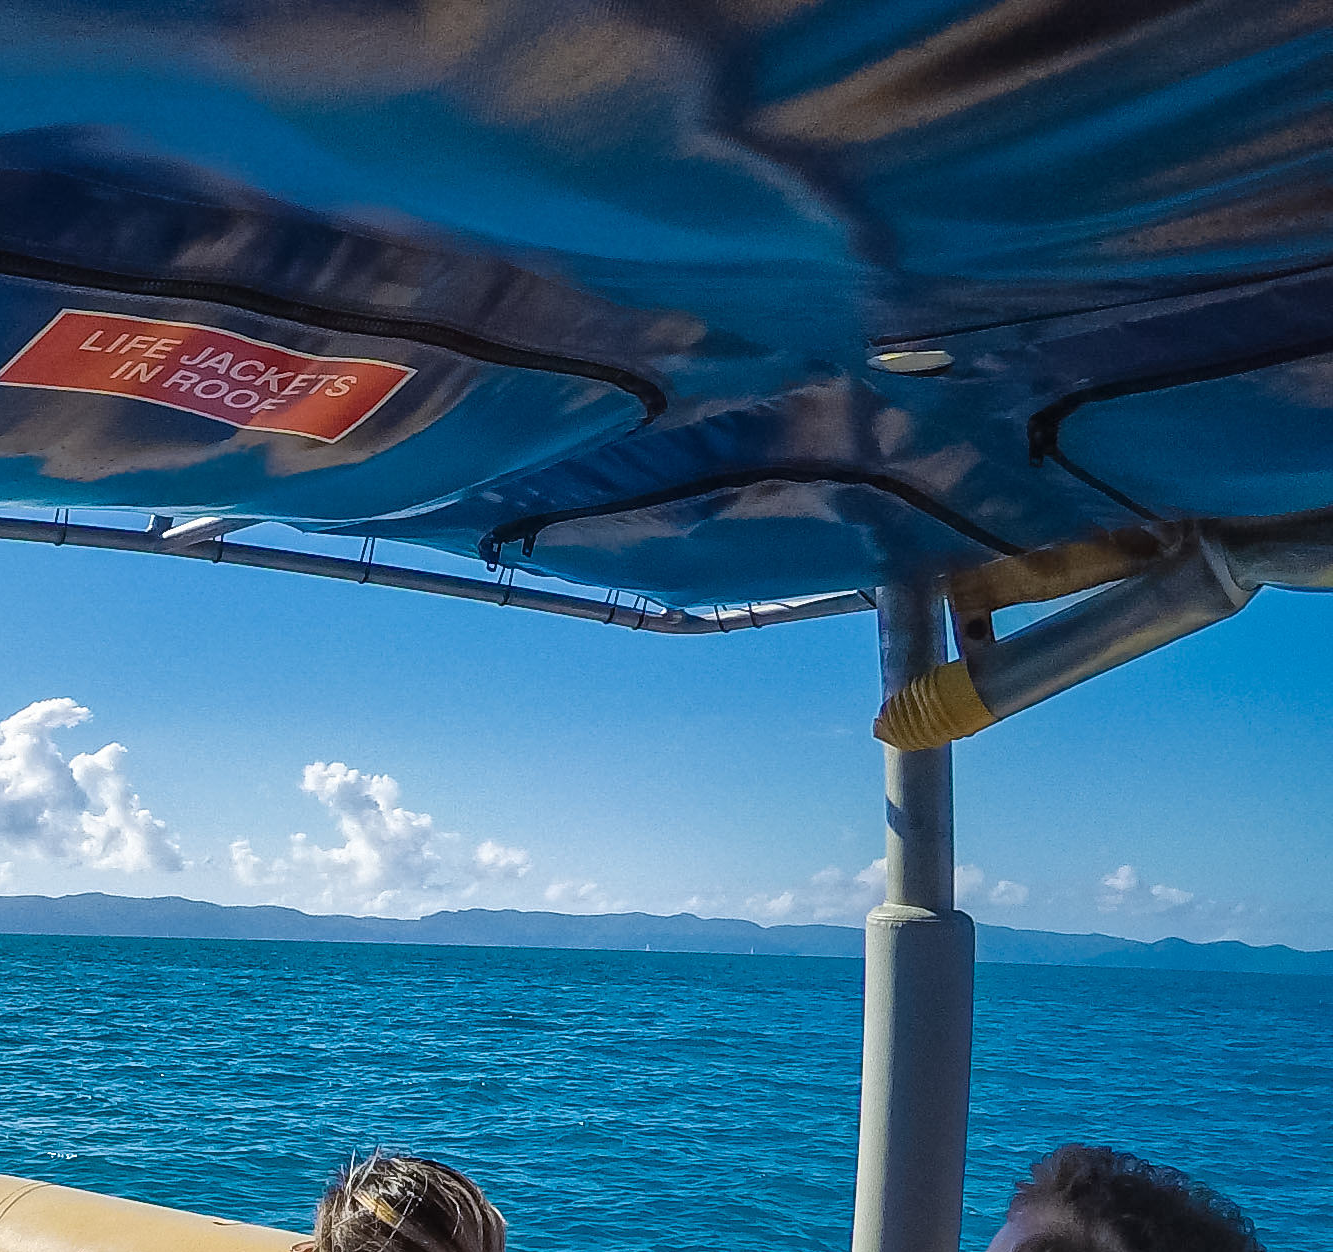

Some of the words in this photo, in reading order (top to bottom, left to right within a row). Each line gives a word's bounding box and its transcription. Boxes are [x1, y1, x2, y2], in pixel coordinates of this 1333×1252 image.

[79, 331, 182, 359] LIFE
[179, 346, 359, 398] JACKETS
[110, 359, 162, 386] IN
[162, 370, 288, 416] ROOF
